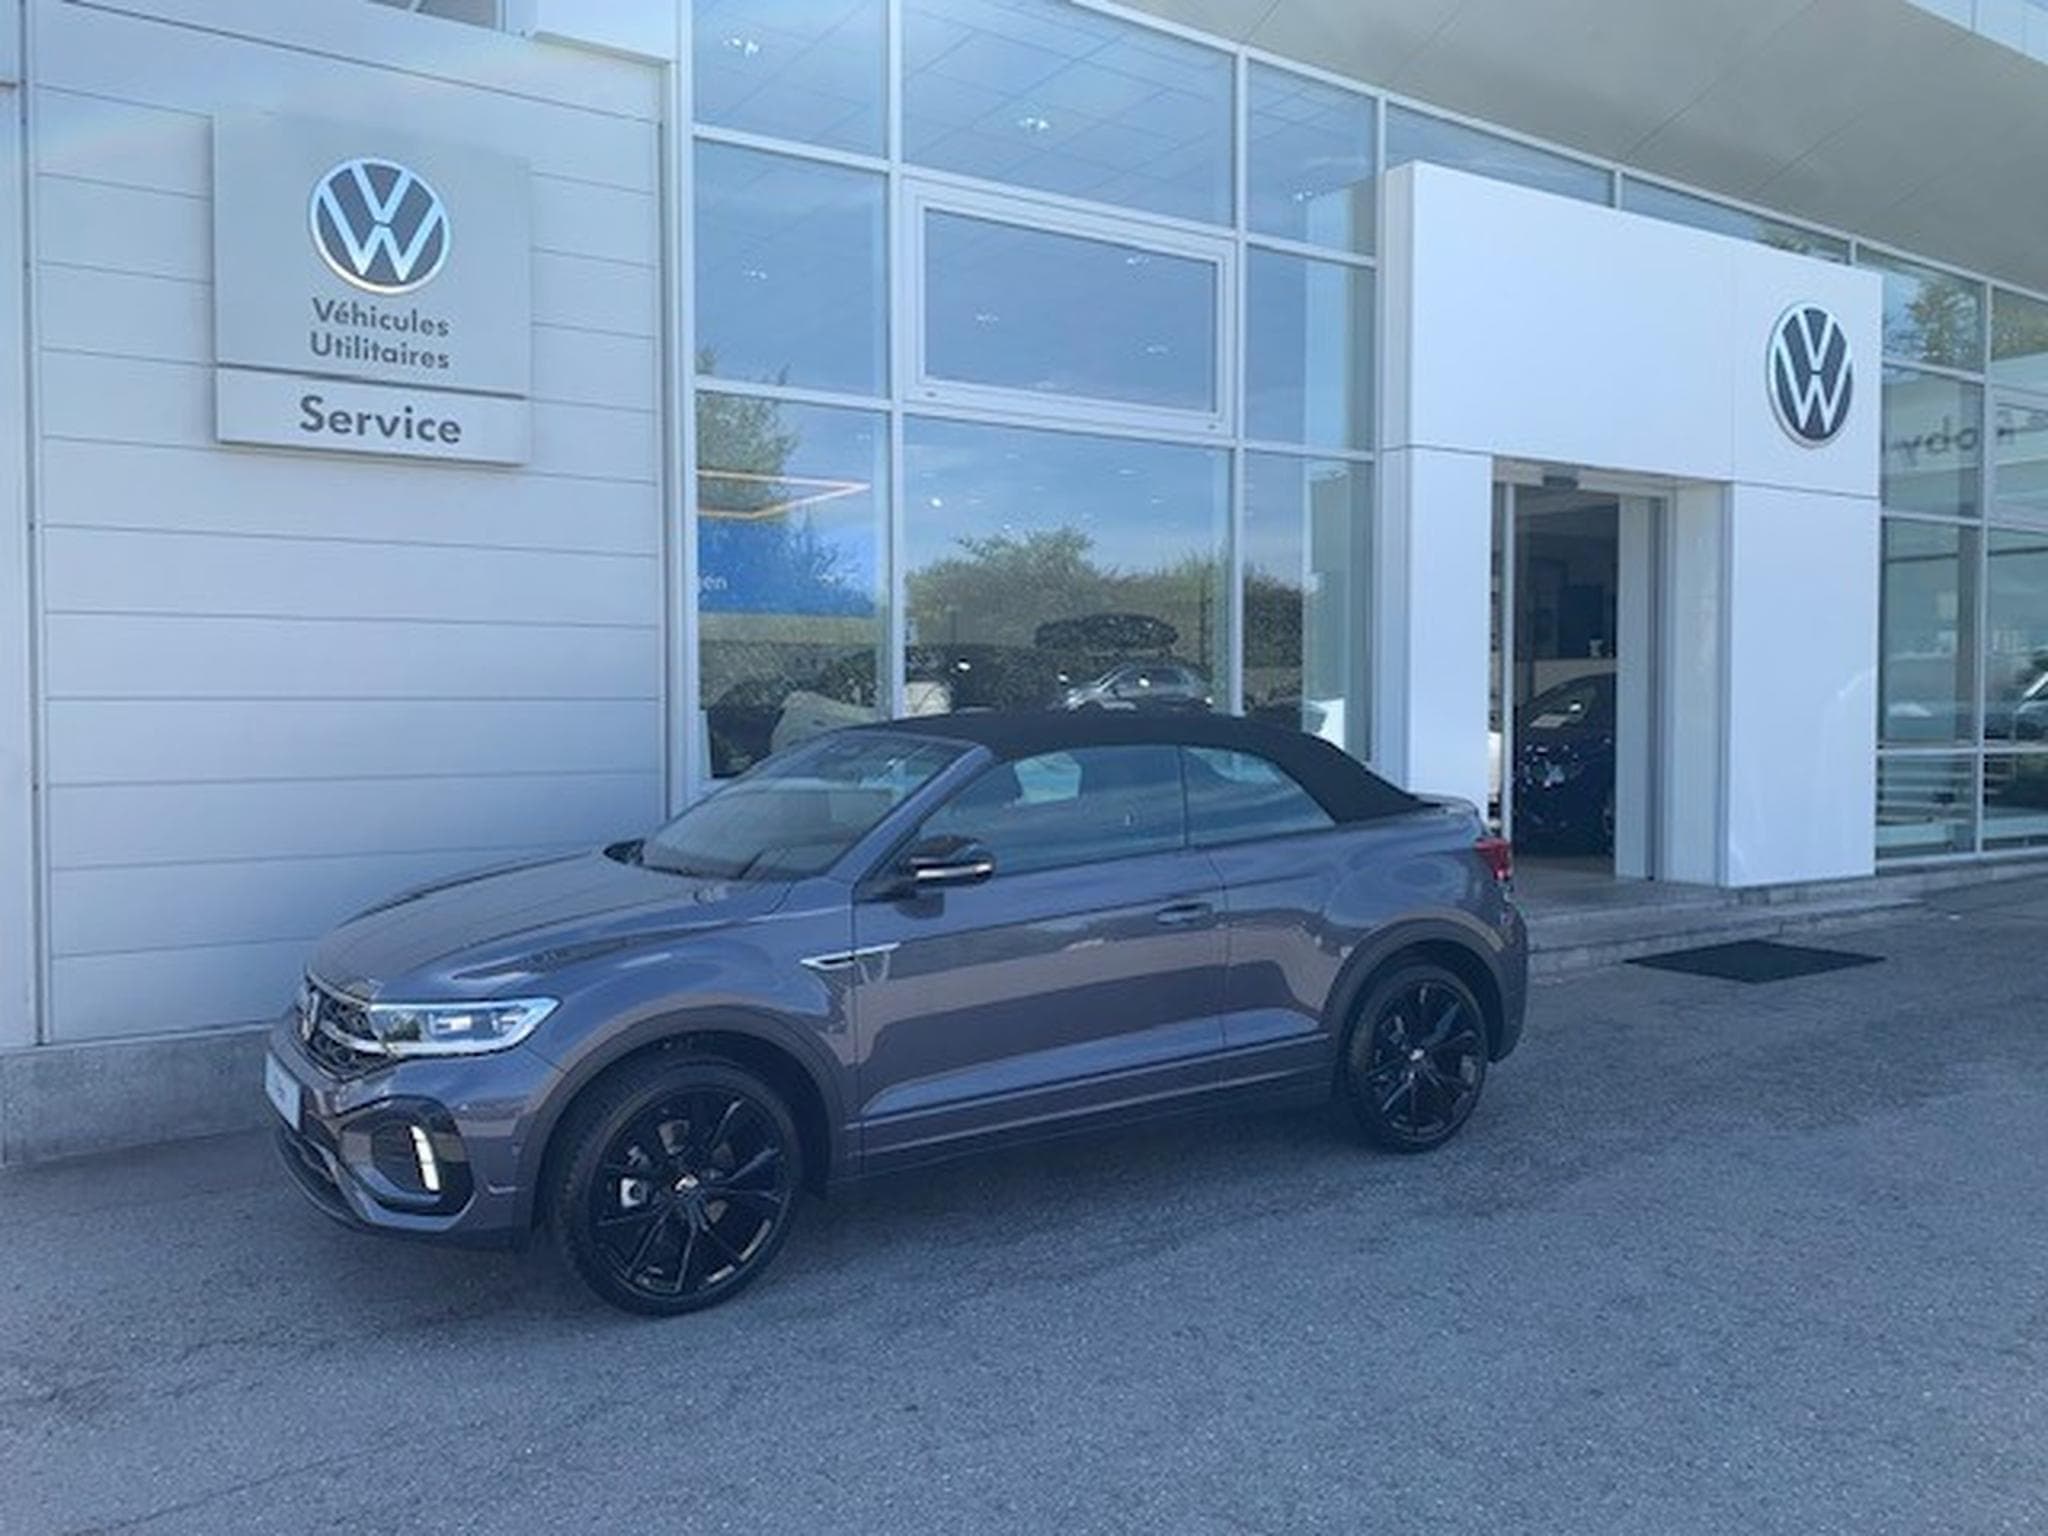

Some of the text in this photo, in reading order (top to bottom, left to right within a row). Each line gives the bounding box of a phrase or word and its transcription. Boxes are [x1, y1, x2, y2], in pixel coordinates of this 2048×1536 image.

[311, 297, 450, 337] Véhicules
[310, 331, 449, 370] Utilitaires
[299, 395, 462, 445] Service
